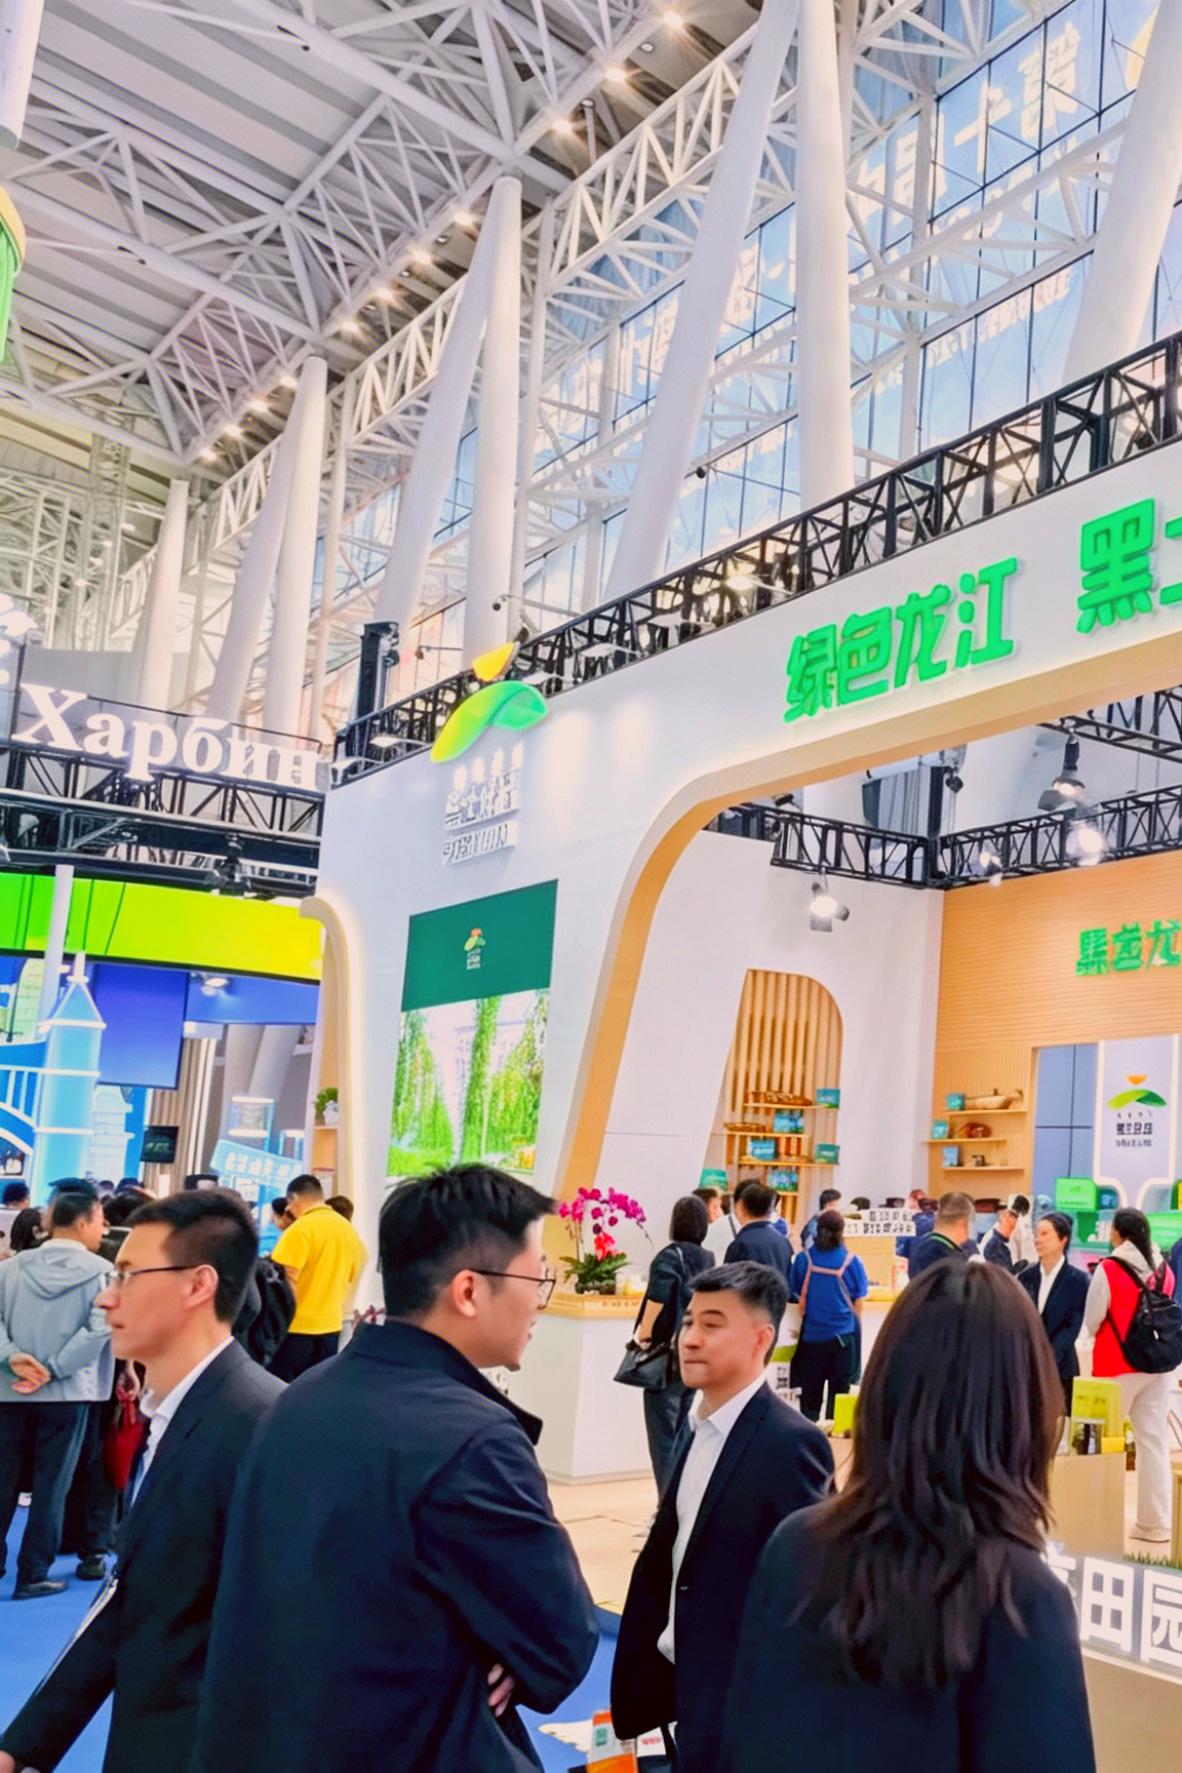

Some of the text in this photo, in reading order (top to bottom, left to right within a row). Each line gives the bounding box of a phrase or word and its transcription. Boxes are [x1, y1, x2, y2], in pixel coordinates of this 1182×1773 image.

[782, 556, 1019, 724] 绿色龙江
[11, 682, 319, 791] Харбин
